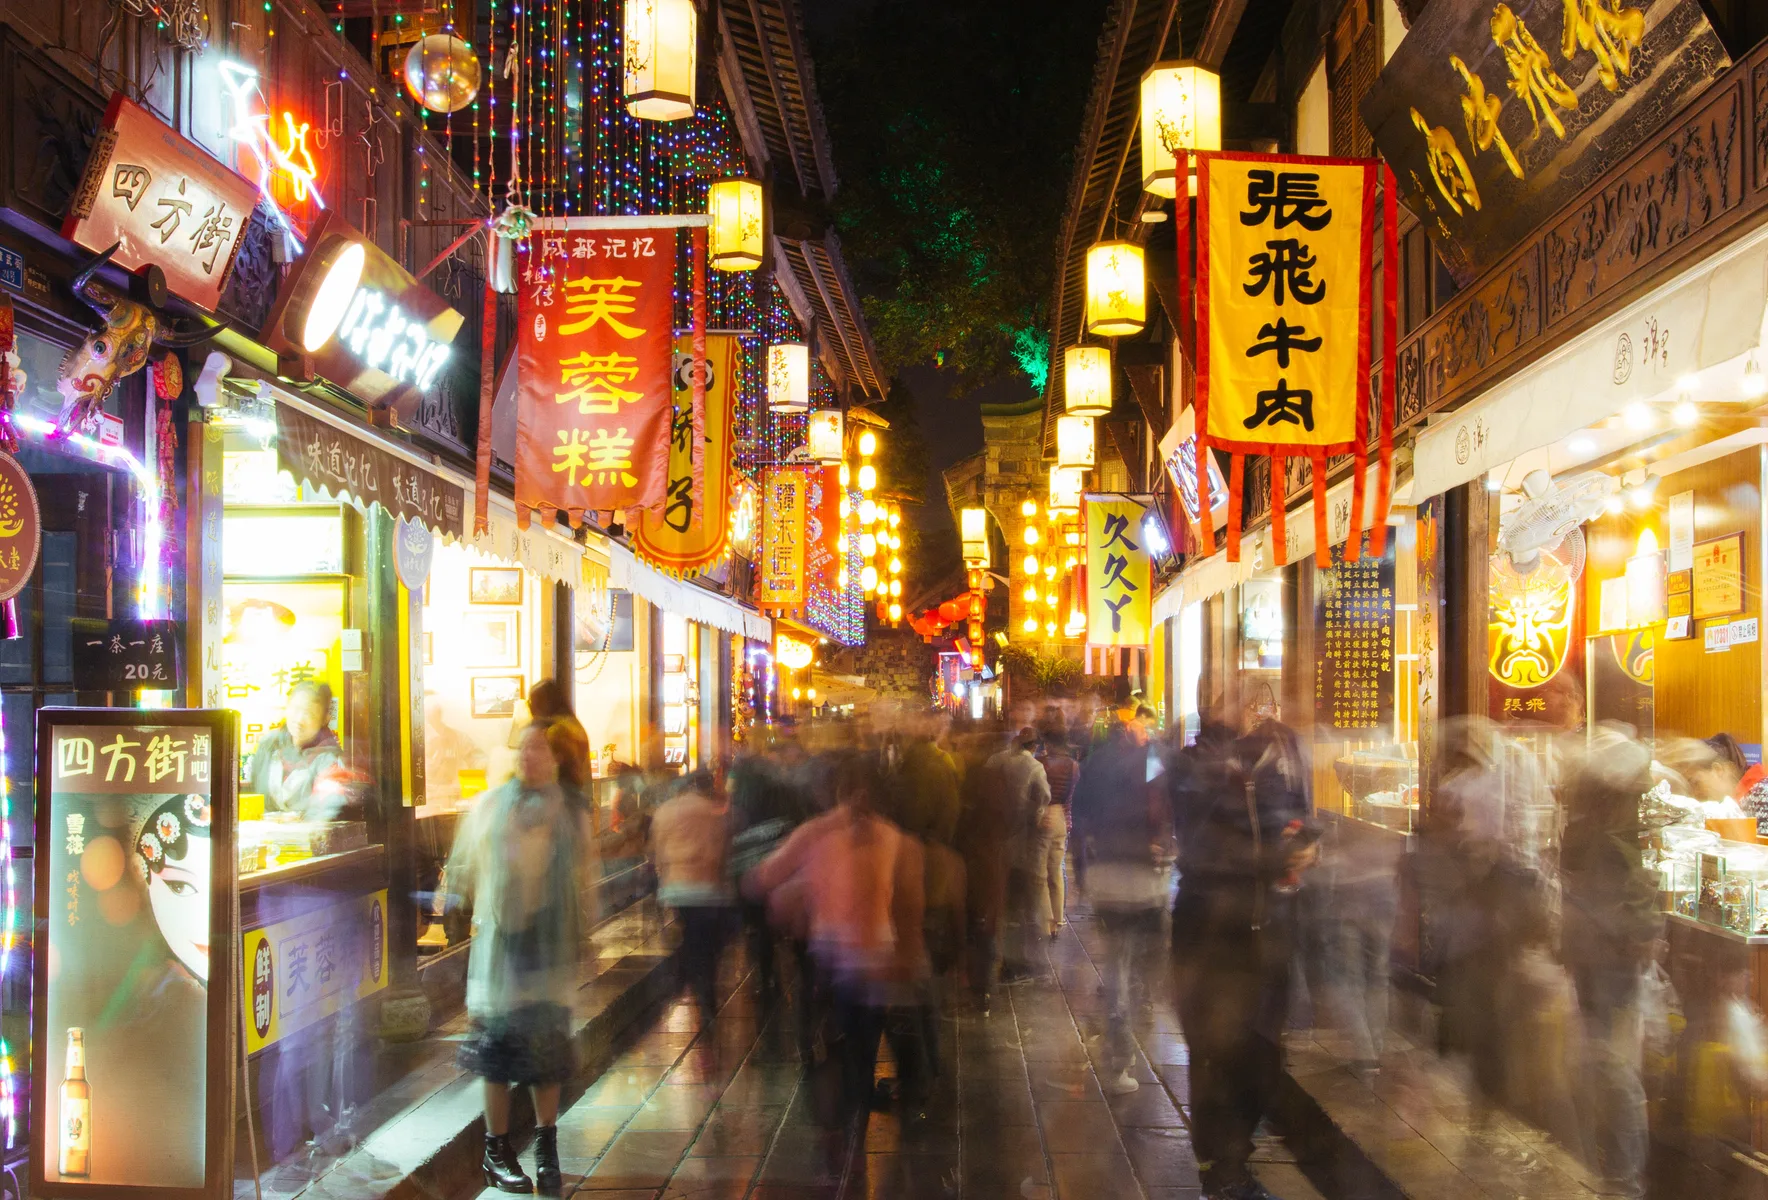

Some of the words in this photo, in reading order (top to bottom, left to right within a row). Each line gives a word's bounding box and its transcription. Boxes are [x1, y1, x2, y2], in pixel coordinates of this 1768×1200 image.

[112, 163, 233, 275] 四方街
[542, 236, 657, 260] 成都记忆
[1240, 169, 1332, 432] 張飛牛肉
[552, 275, 647, 488] 芙蓉糕
[307, 432, 378, 492] 味道记忆
[392, 467, 443, 522] 味道记忆
[1100, 512, 1139, 633] 久久丫
[86, 634, 164, 654] 一茶一座
[124, 663, 168, 680] 20元
[1503, 698, 1546, 712] 張飛
[58, 733, 189, 783] 四方街
[191, 734, 209, 783] 酒吧
